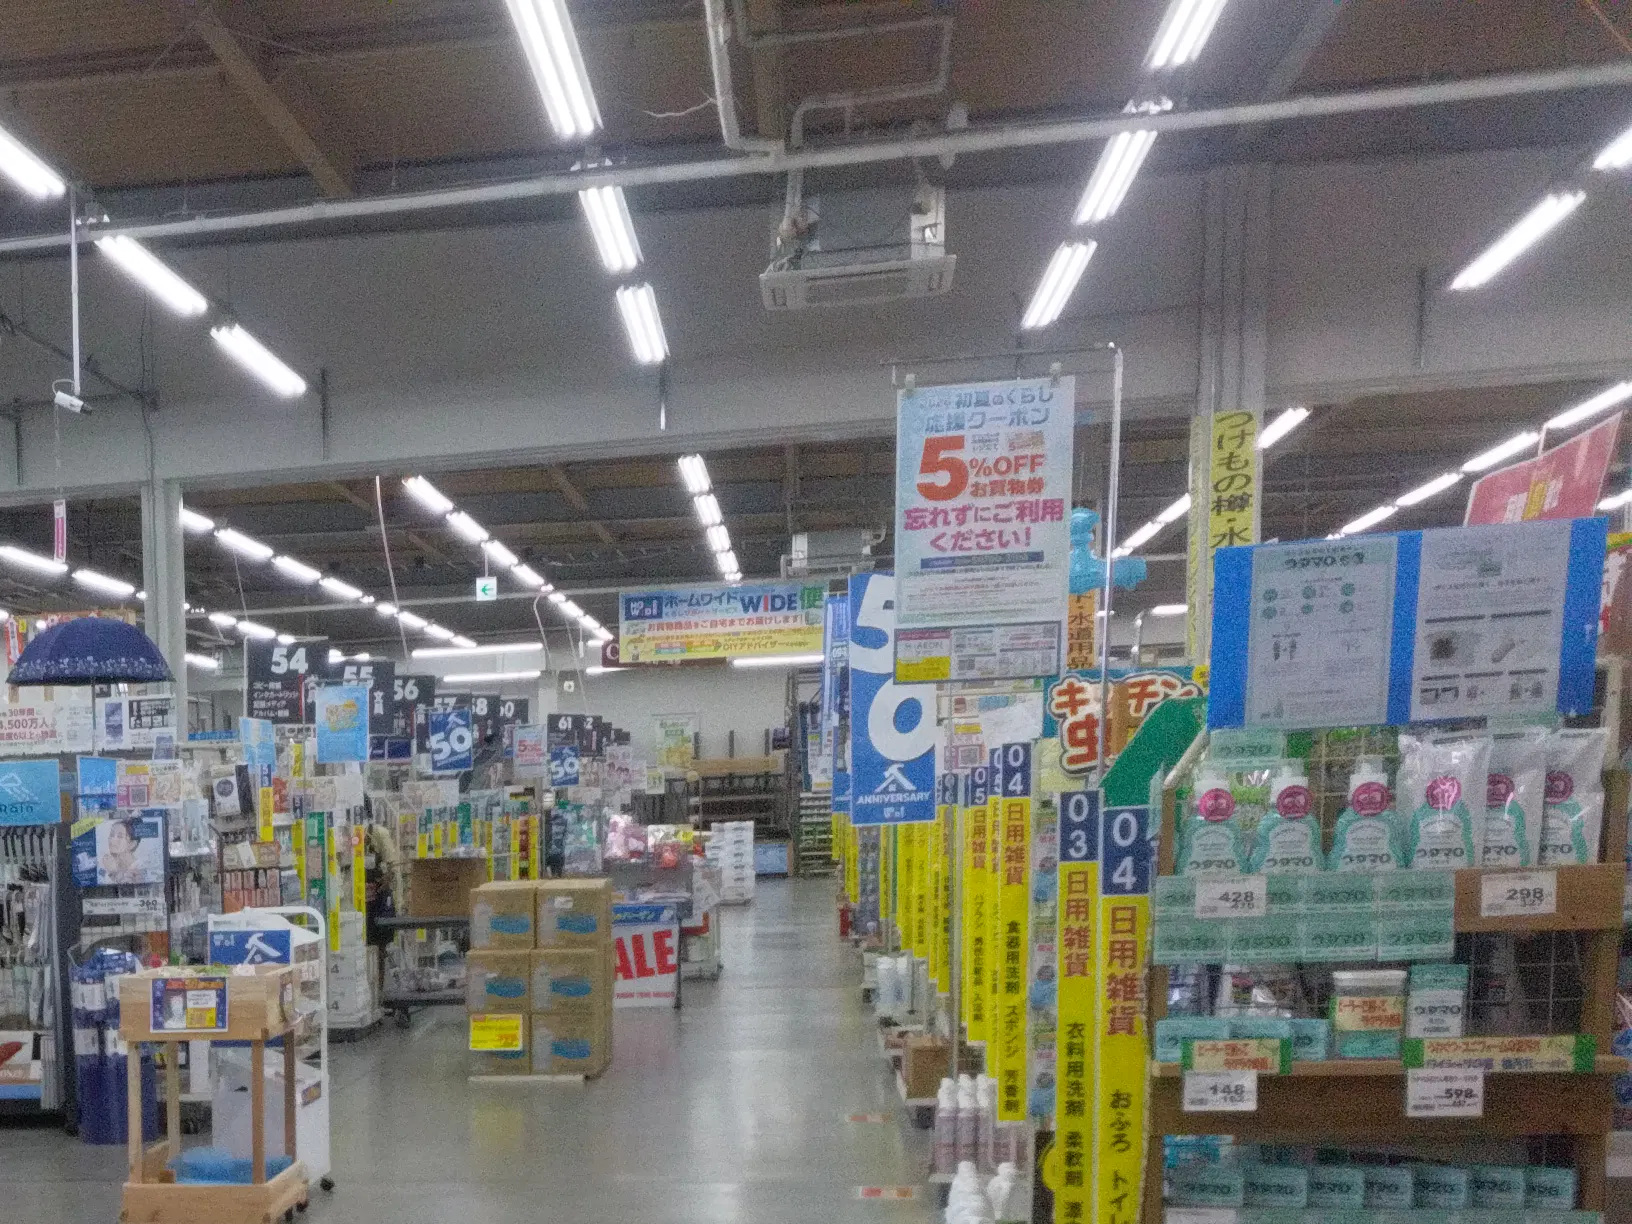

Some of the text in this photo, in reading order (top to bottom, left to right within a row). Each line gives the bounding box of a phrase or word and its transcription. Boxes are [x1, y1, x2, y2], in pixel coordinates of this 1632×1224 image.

[925, 408, 1050, 433] 応援クーポン
[971, 477, 1045, 498] お買物券
[903, 498, 1064, 531] 忘れずにご利用
[930, 527, 1032, 552] ください!
[664, 591, 738, 608] ホームワイド
[270, 647, 309, 675] 54
[393, 681, 419, 701] 56
[856, 791, 930, 805] ANNIVERSARY
[1068, 794, 1090, 858] 03
[1004, 802, 1026, 886] 日用雑貨
[1112, 811, 1138, 891] 04
[1218, 891, 1255, 904] 428
[1506, 887, 1544, 901] 298
[1062, 869, 1091, 978] 日用雑貨
[613, 929, 678, 981] ALE
[1105, 905, 1140, 1036] 日用雑貨
[1207, 1083, 1245, 1097] 148
[1444, 1088, 1474, 1100] 598
[1109, 1088, 1133, 1154] おふろ
